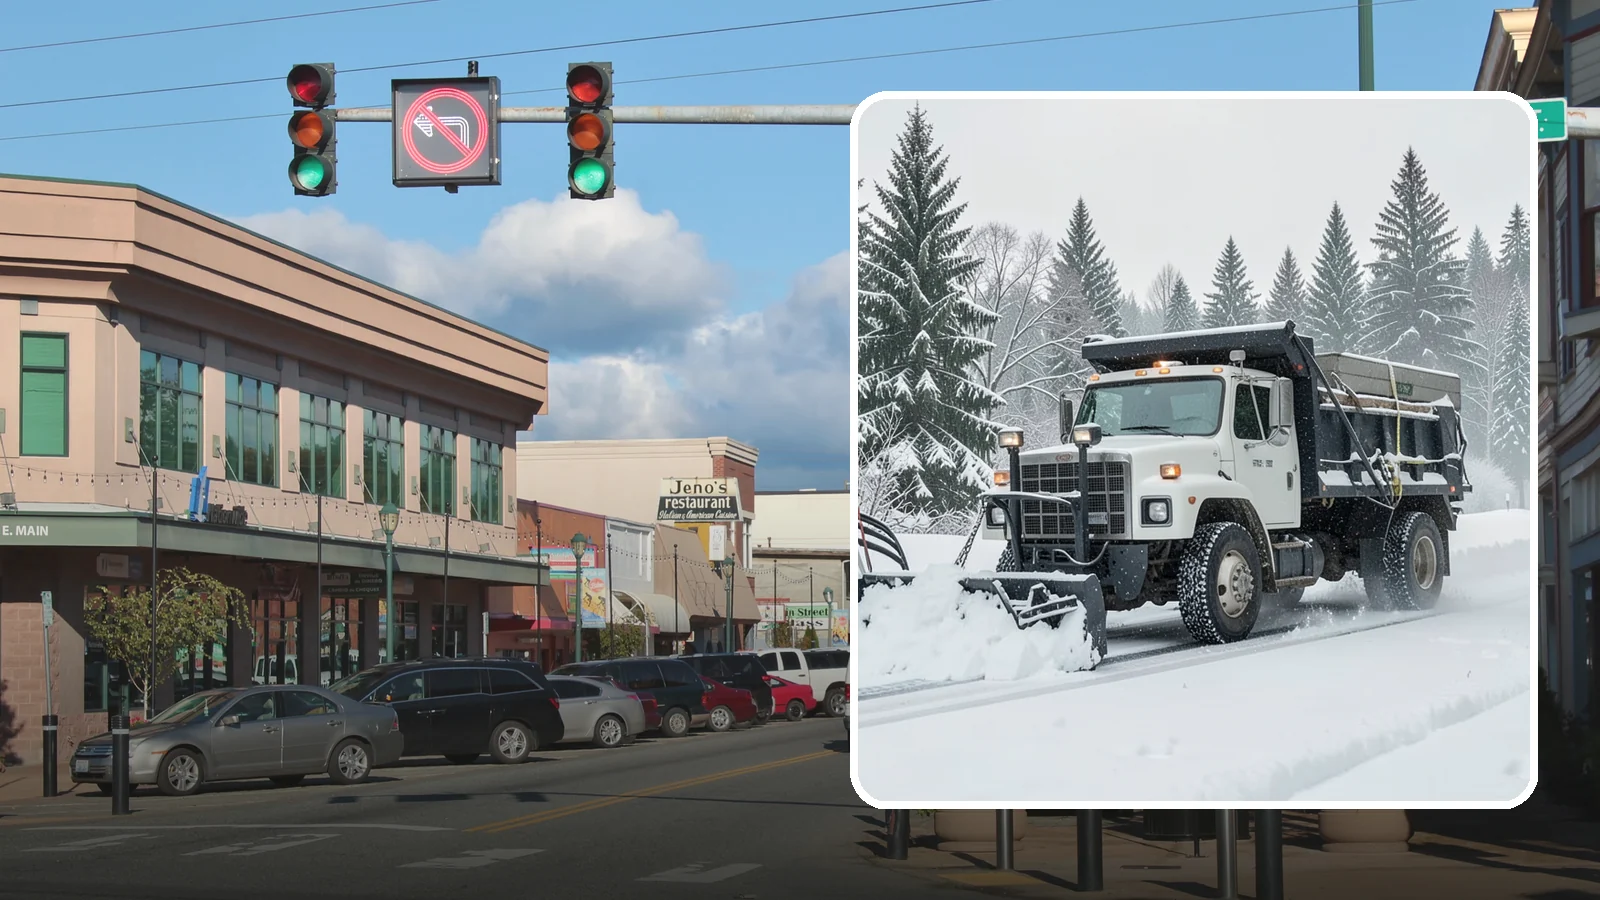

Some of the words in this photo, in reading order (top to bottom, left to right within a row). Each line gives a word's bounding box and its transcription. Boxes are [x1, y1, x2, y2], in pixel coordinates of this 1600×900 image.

[670, 480, 727, 494] Jeno's
[665, 497, 731, 509] restaurant
[659, 510, 682, 520] Italian
[686, 510, 715, 519] American
[714, 509, 737, 519] Cuisine
[2, 525, 13, 536] E.
[15, 525, 49, 536] MAIN
[797, 607, 828, 617] Street
